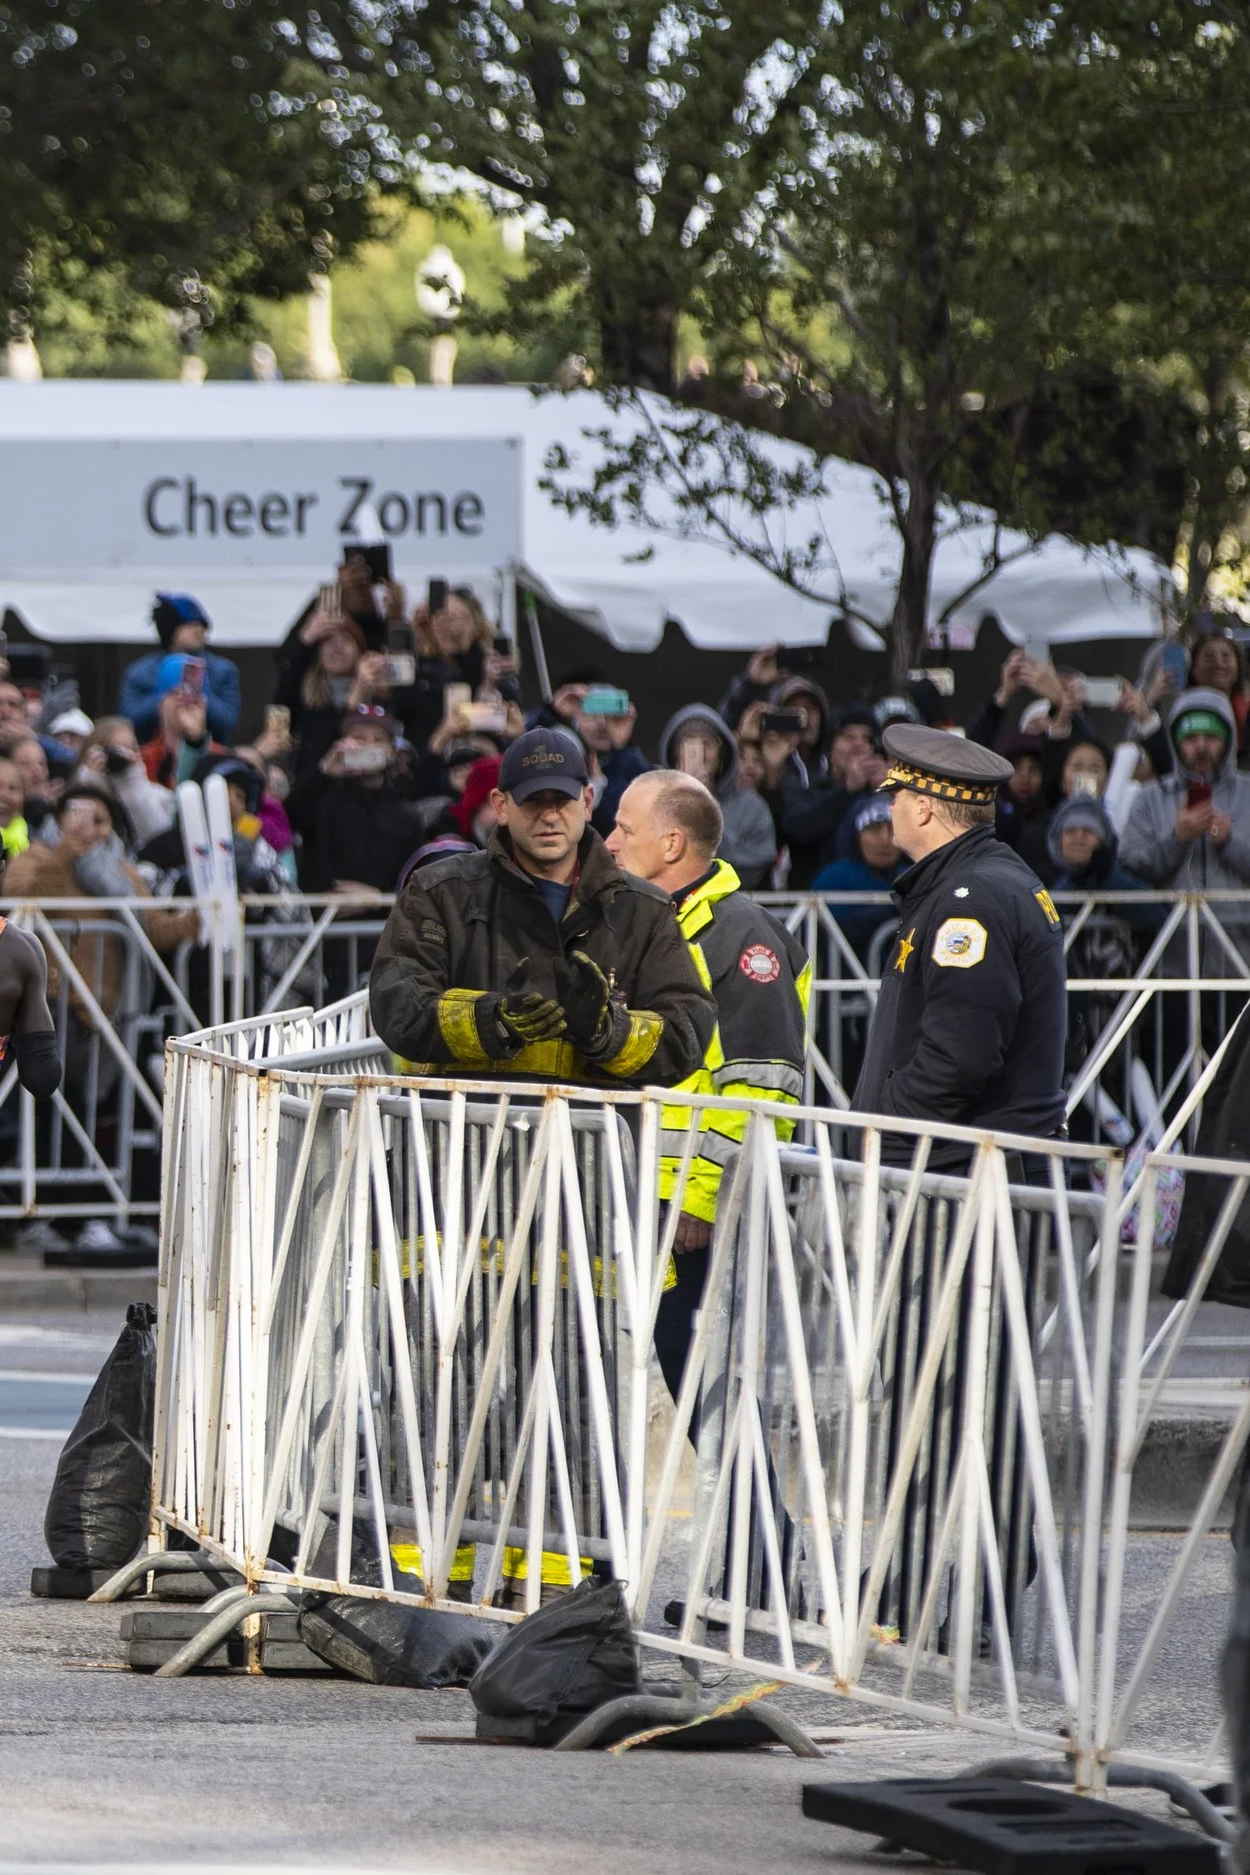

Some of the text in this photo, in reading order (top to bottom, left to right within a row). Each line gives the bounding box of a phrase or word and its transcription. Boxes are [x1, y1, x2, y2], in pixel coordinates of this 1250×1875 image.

[144, 474, 485, 537] Cheer Zone
[522, 753, 565, 767] SQUAD
